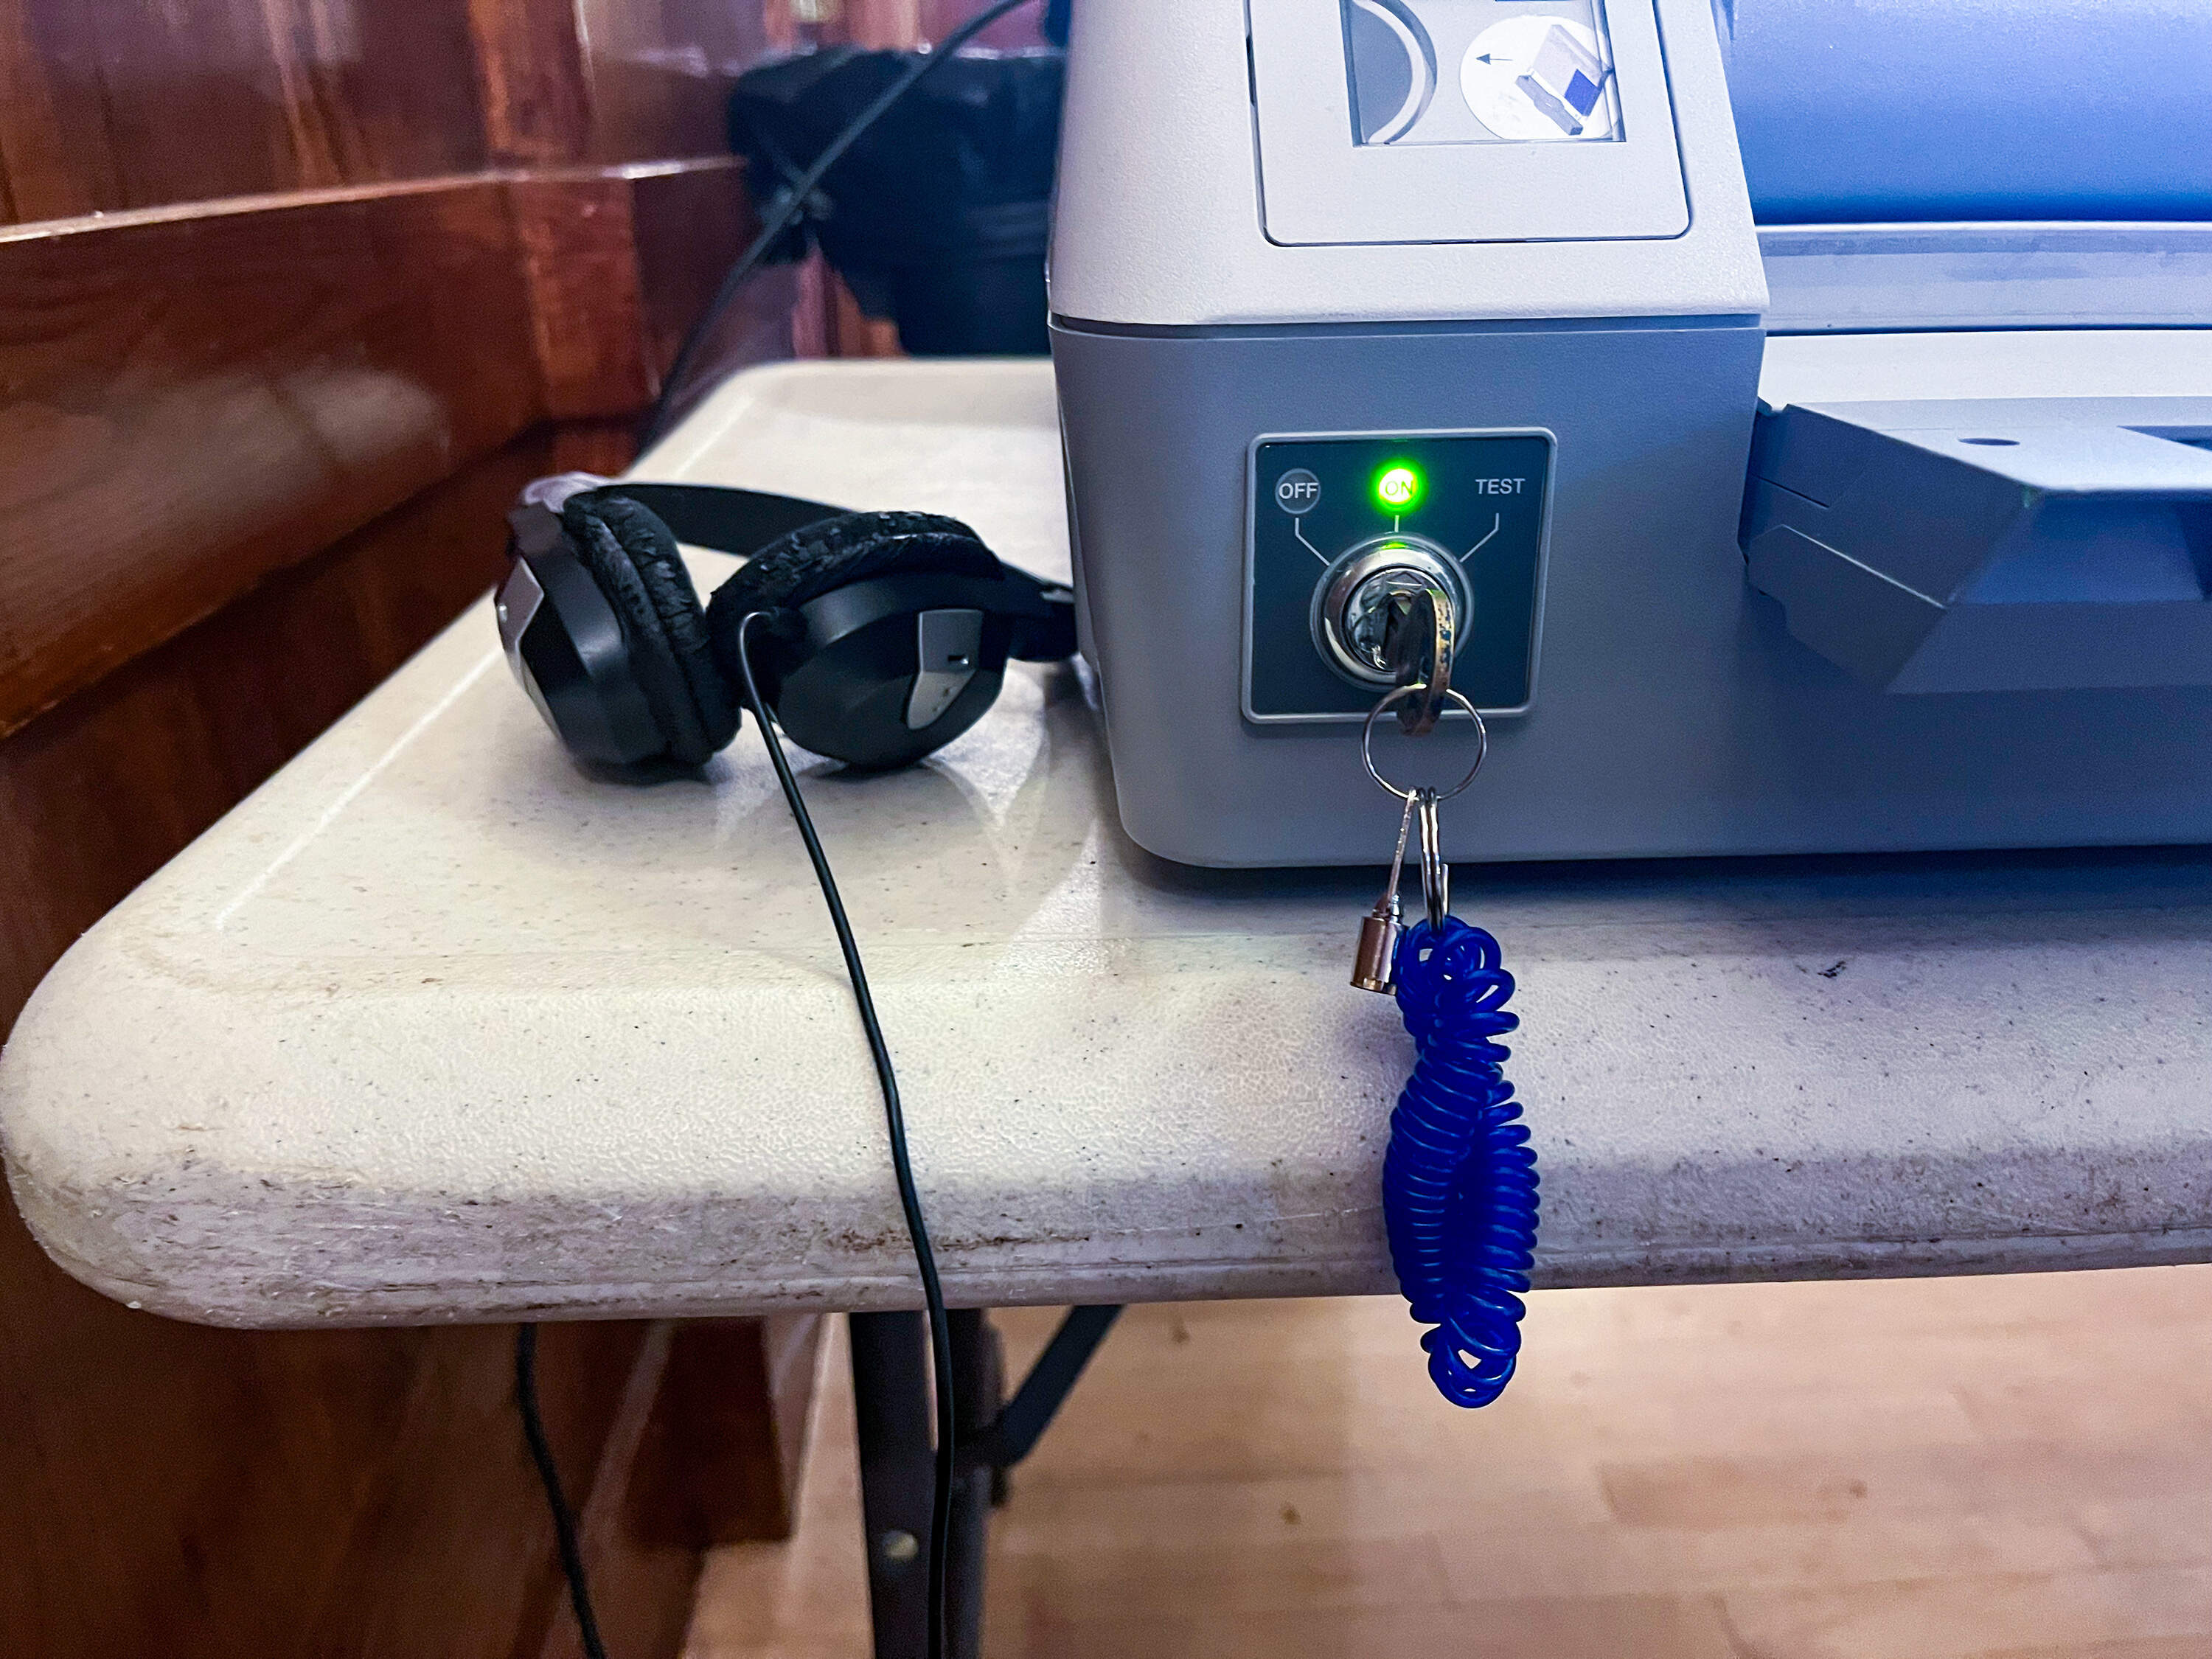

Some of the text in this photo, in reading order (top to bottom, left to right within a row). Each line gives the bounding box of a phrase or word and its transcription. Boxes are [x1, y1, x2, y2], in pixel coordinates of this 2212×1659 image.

[1279, 481, 1319, 499] OFF
[1385, 481, 1414, 495] ON
[1475, 478, 1526, 495] TEST
